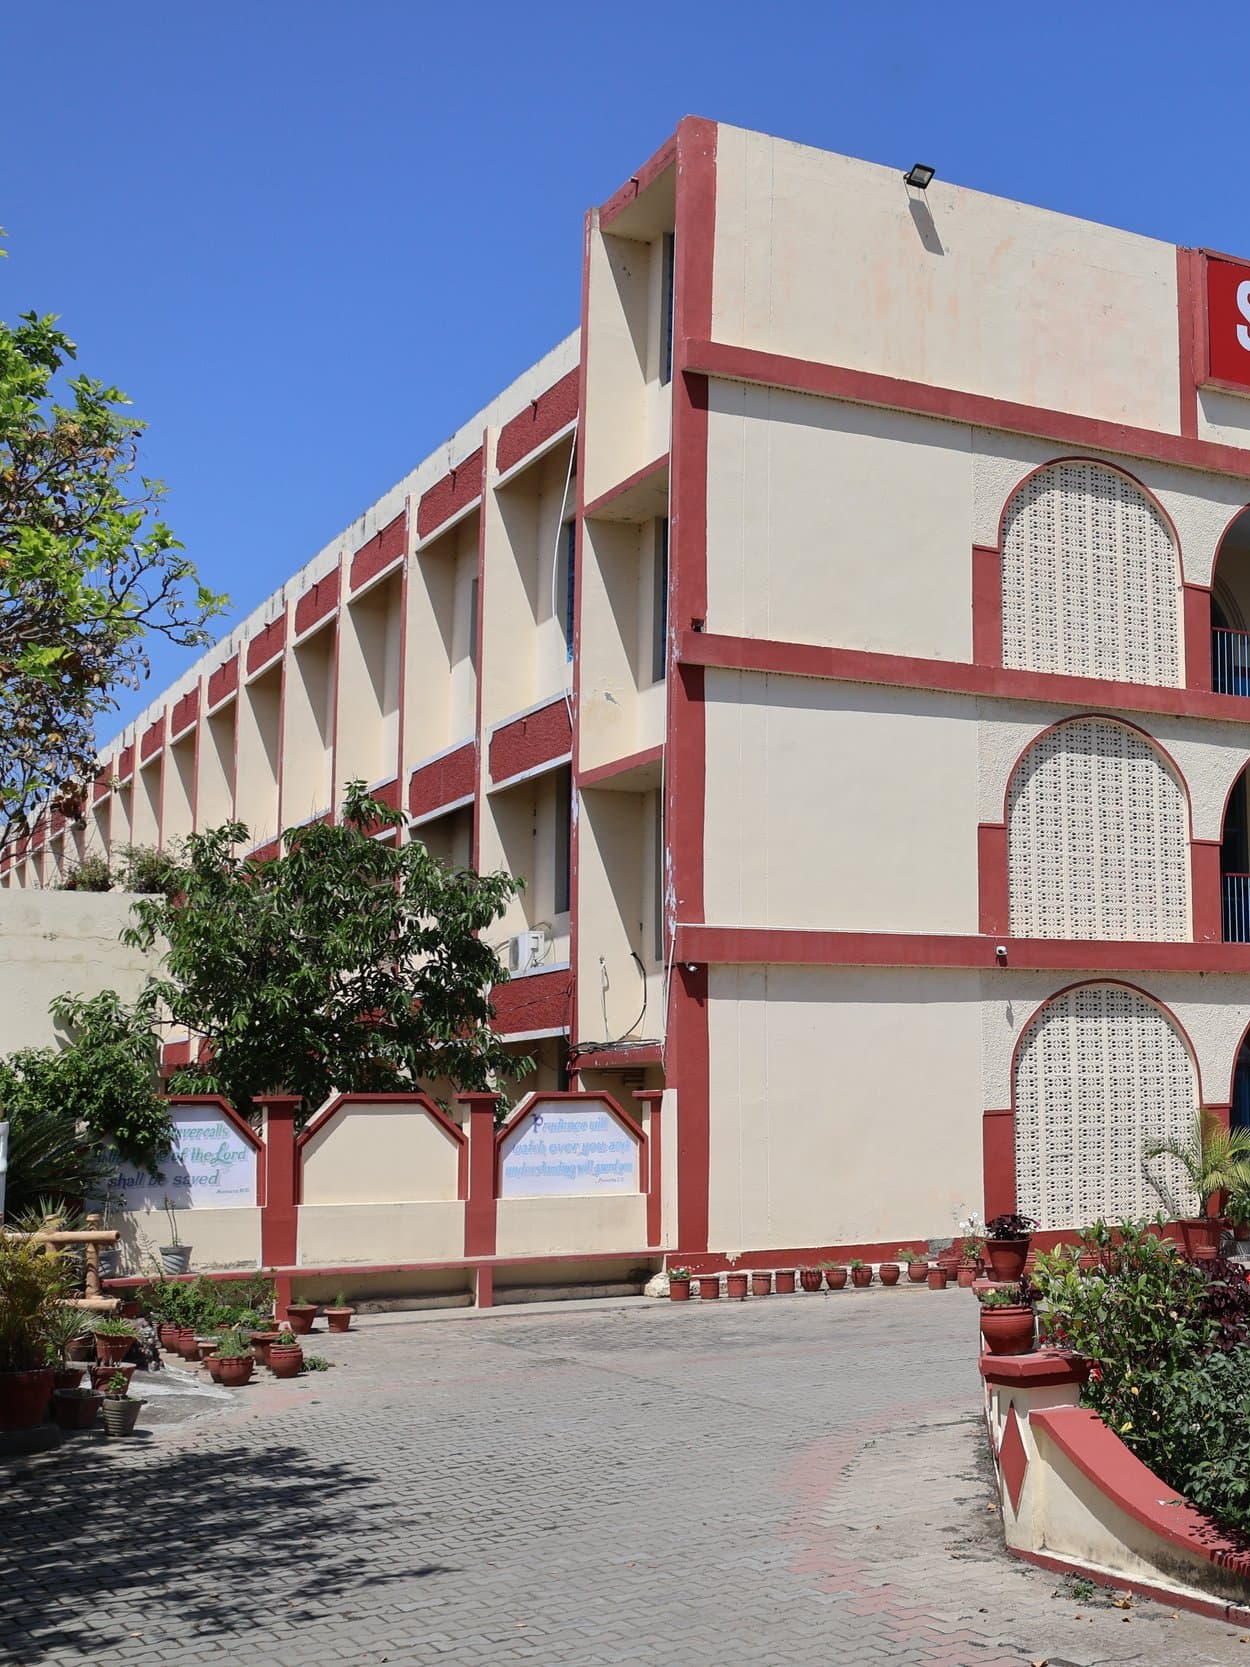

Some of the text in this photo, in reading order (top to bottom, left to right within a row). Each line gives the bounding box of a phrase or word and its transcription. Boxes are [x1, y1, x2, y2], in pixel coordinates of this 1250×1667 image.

[202, 1123, 230, 1139] calls
[190, 1147, 212, 1162] the
[210, 1142, 248, 1166] Lord
[548, 1142, 578, 1155] over
[108, 1171, 145, 1189] shall
[173, 1169, 220, 1187] saved
